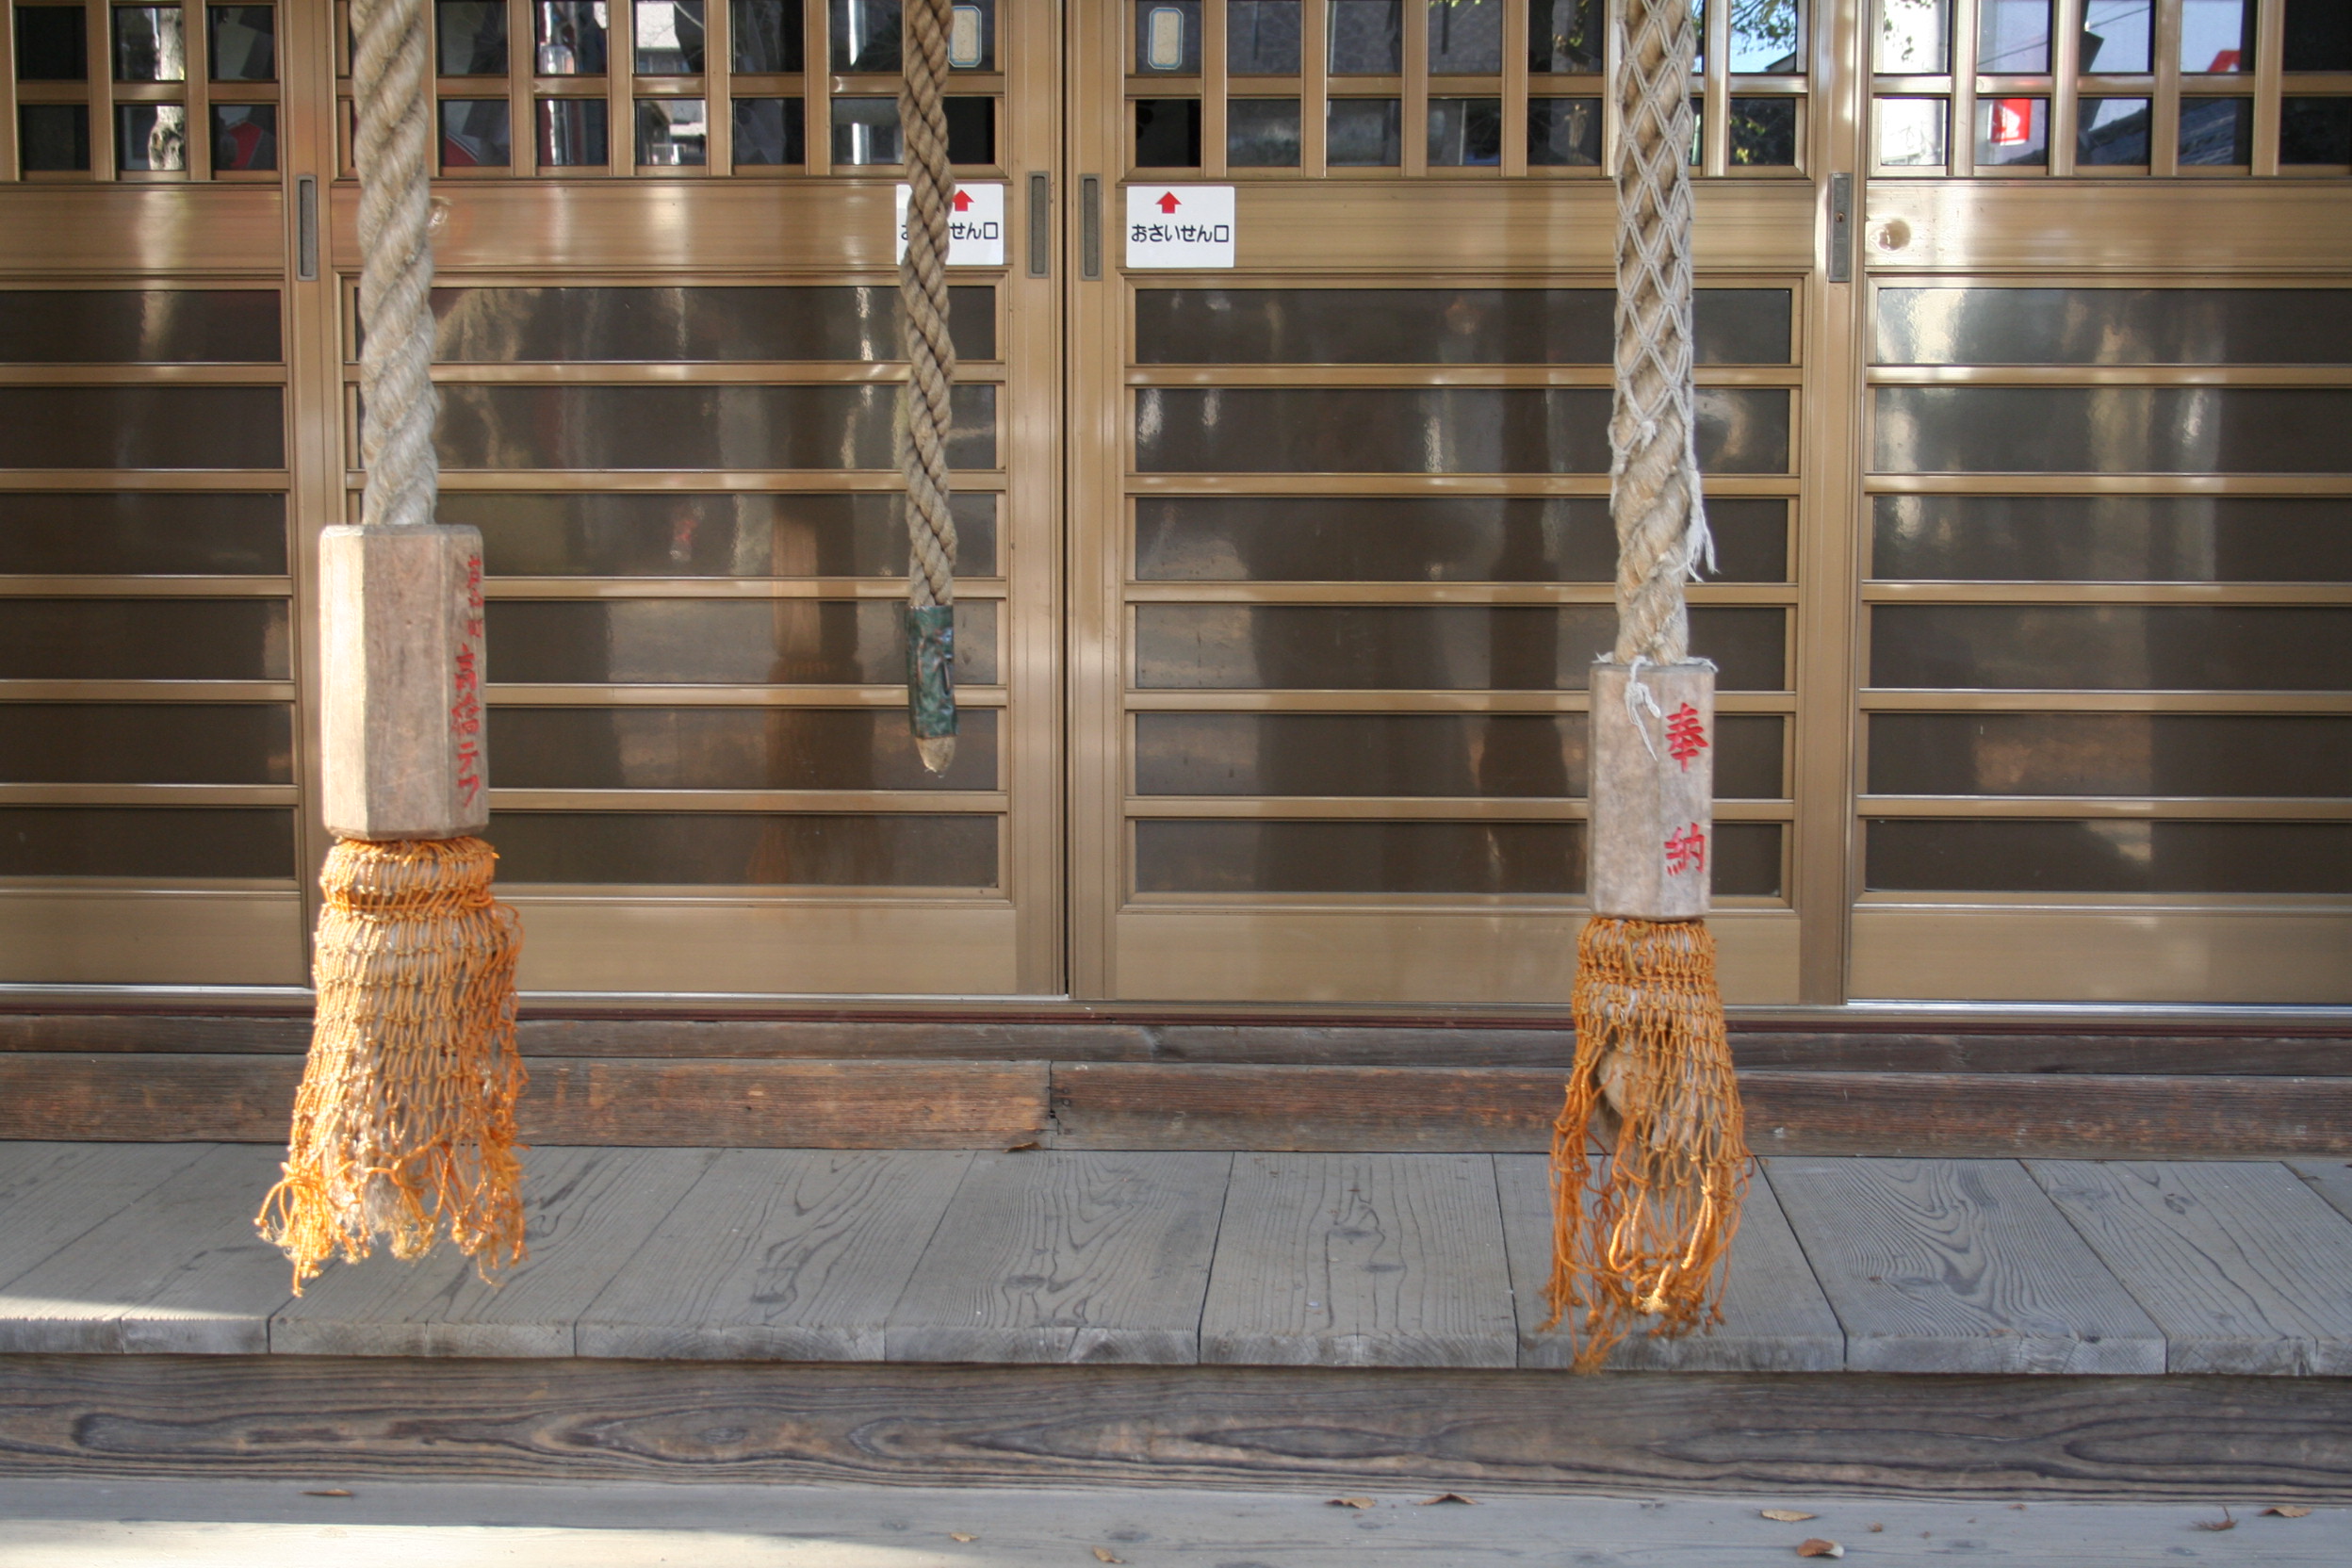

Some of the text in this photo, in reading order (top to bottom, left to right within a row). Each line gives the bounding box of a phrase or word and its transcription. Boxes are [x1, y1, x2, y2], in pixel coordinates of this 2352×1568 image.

[901, 221, 999, 240] せん口
[1131, 223, 1230, 243] おさいせん口
[1664, 702, 1708, 876] 奉納
